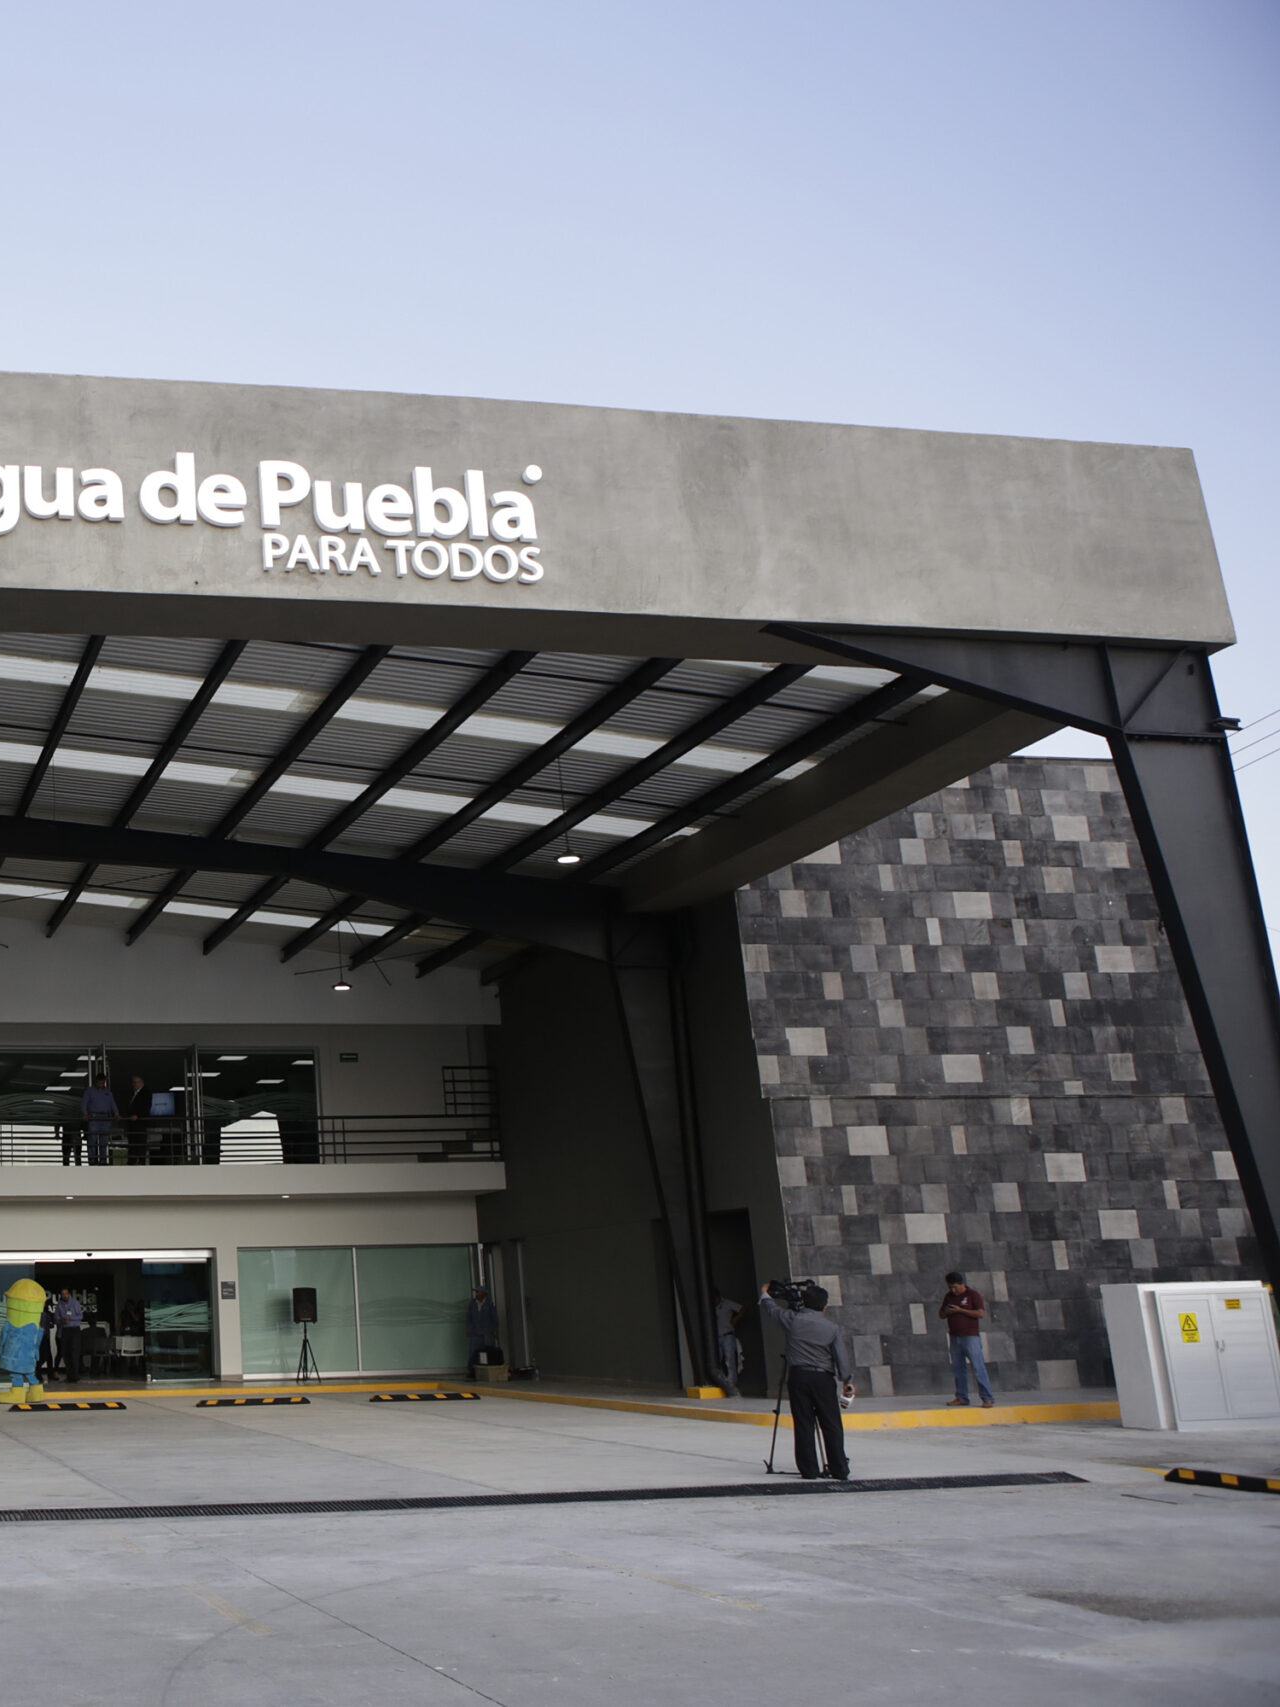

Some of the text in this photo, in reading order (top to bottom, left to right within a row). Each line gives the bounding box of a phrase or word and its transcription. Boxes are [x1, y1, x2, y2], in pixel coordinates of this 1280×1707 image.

[139, 452, 247, 528] de
[257, 460, 538, 544] Puebla
[261, 533, 545, 585] PARA TODOS
